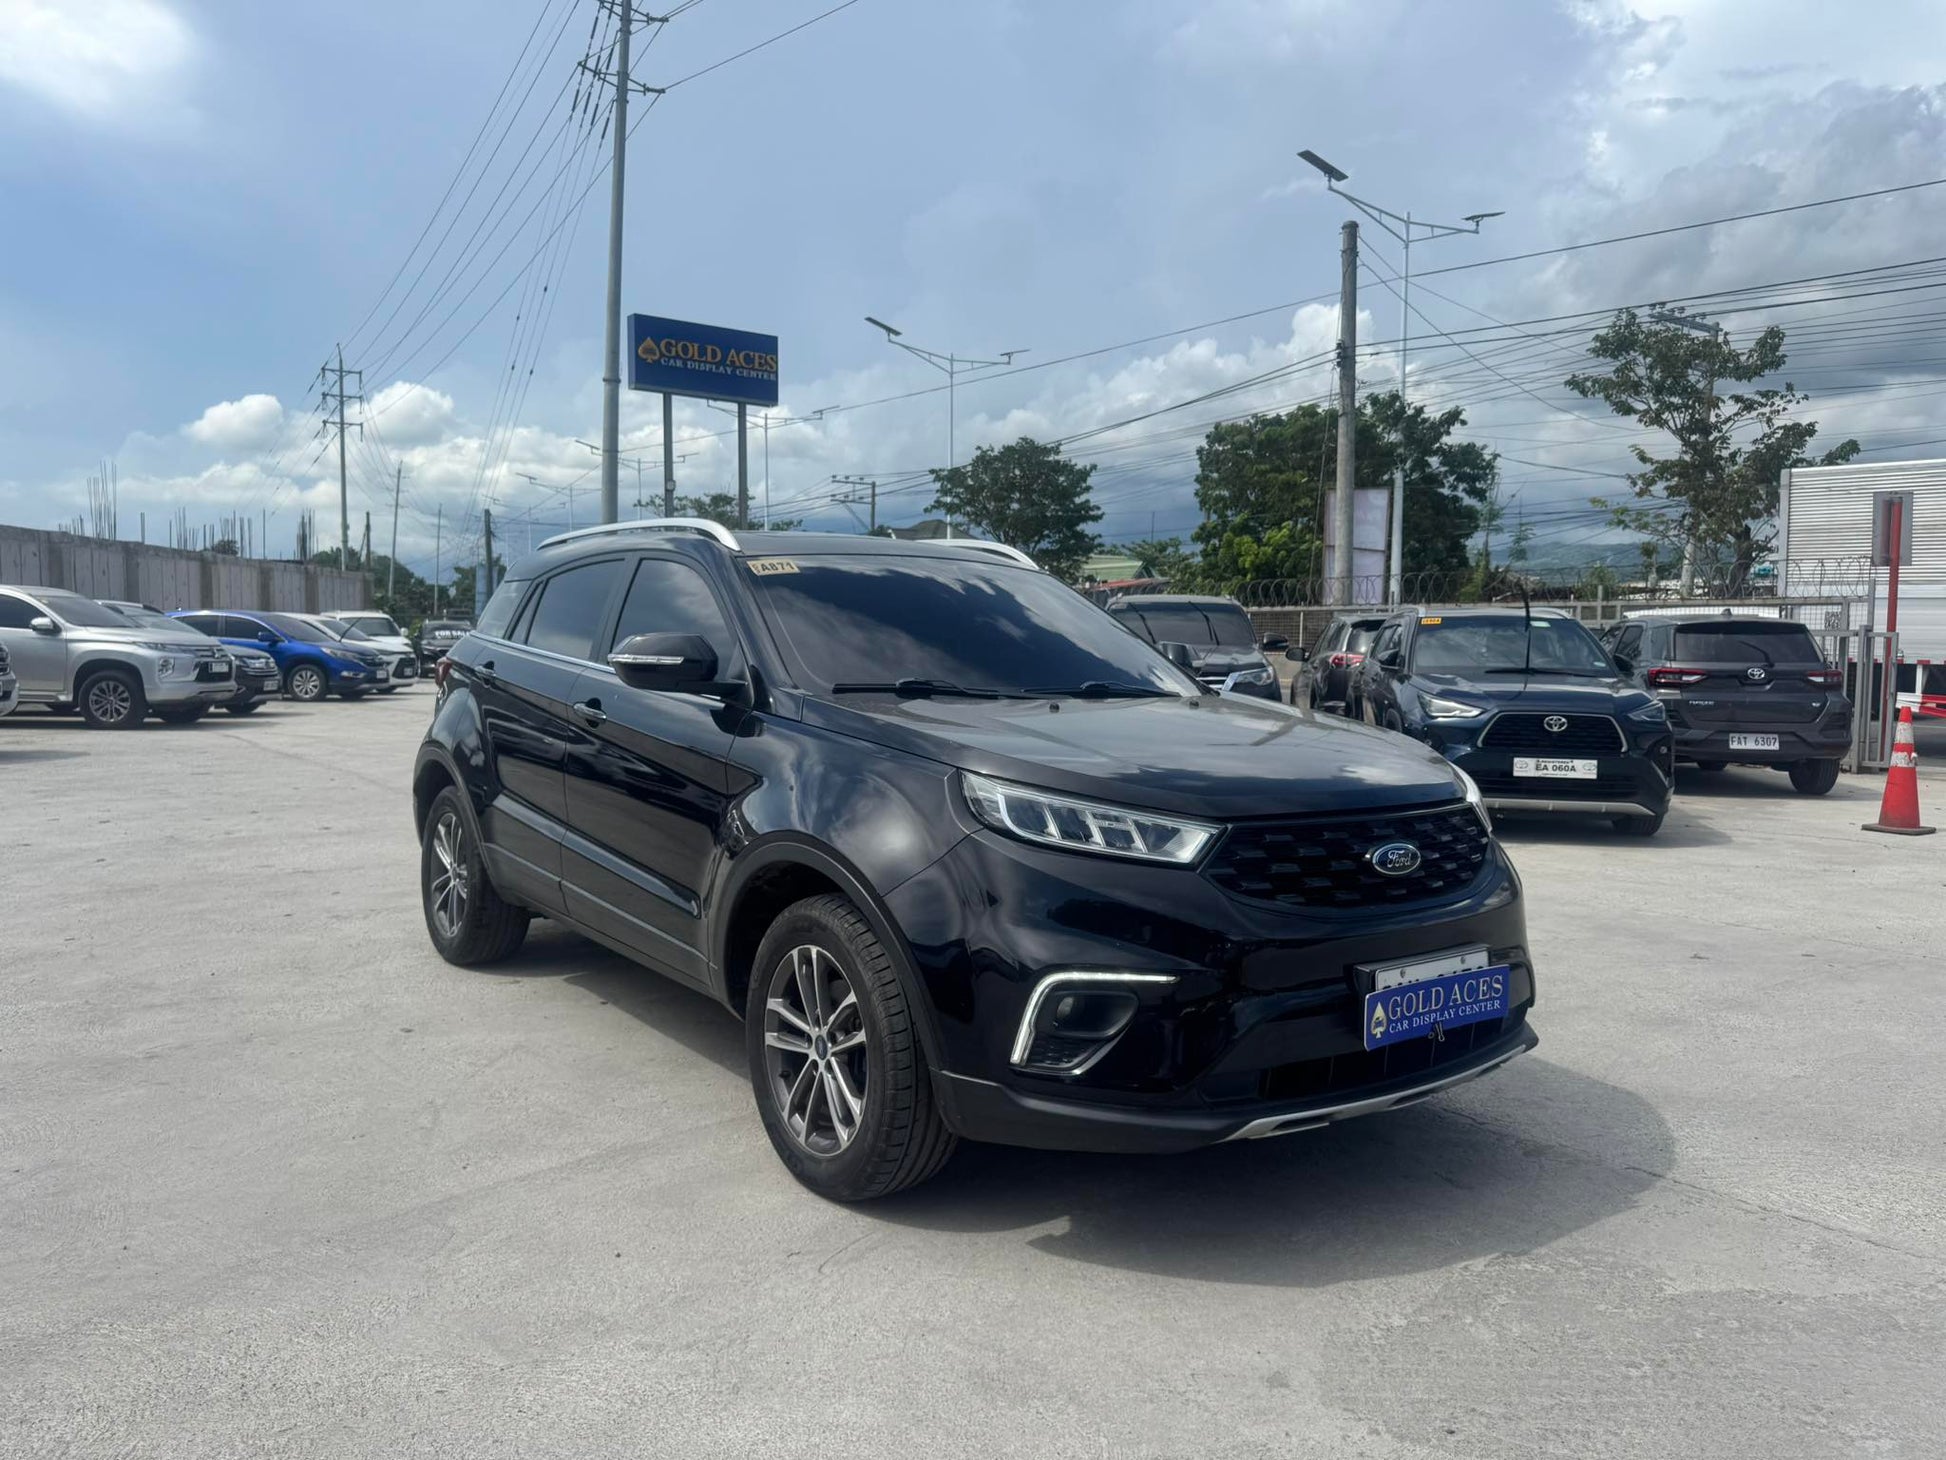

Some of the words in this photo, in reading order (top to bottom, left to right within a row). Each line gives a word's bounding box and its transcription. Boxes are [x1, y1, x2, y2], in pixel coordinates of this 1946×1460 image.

[660, 338, 722, 363] GOLD
[726, 348, 777, 372] ACES
[660, 357, 684, 369] CAR
[687, 361, 734, 376] DISPLAY
[736, 369, 777, 381] CENTER
[1730, 736, 1748, 746] FAT
[1754, 736, 1777, 746] 6307
[1535, 764, 1549, 772] EA
[1387, 850, 1412, 867] Ford
[1388, 986, 1444, 1020] GOLD
[1450, 975, 1504, 1006] ACES
[1389, 1021, 1410, 1034] CAR
[1413, 1009, 1456, 1027] DISPLAY
[1458, 1000, 1501, 1016] CENTER
